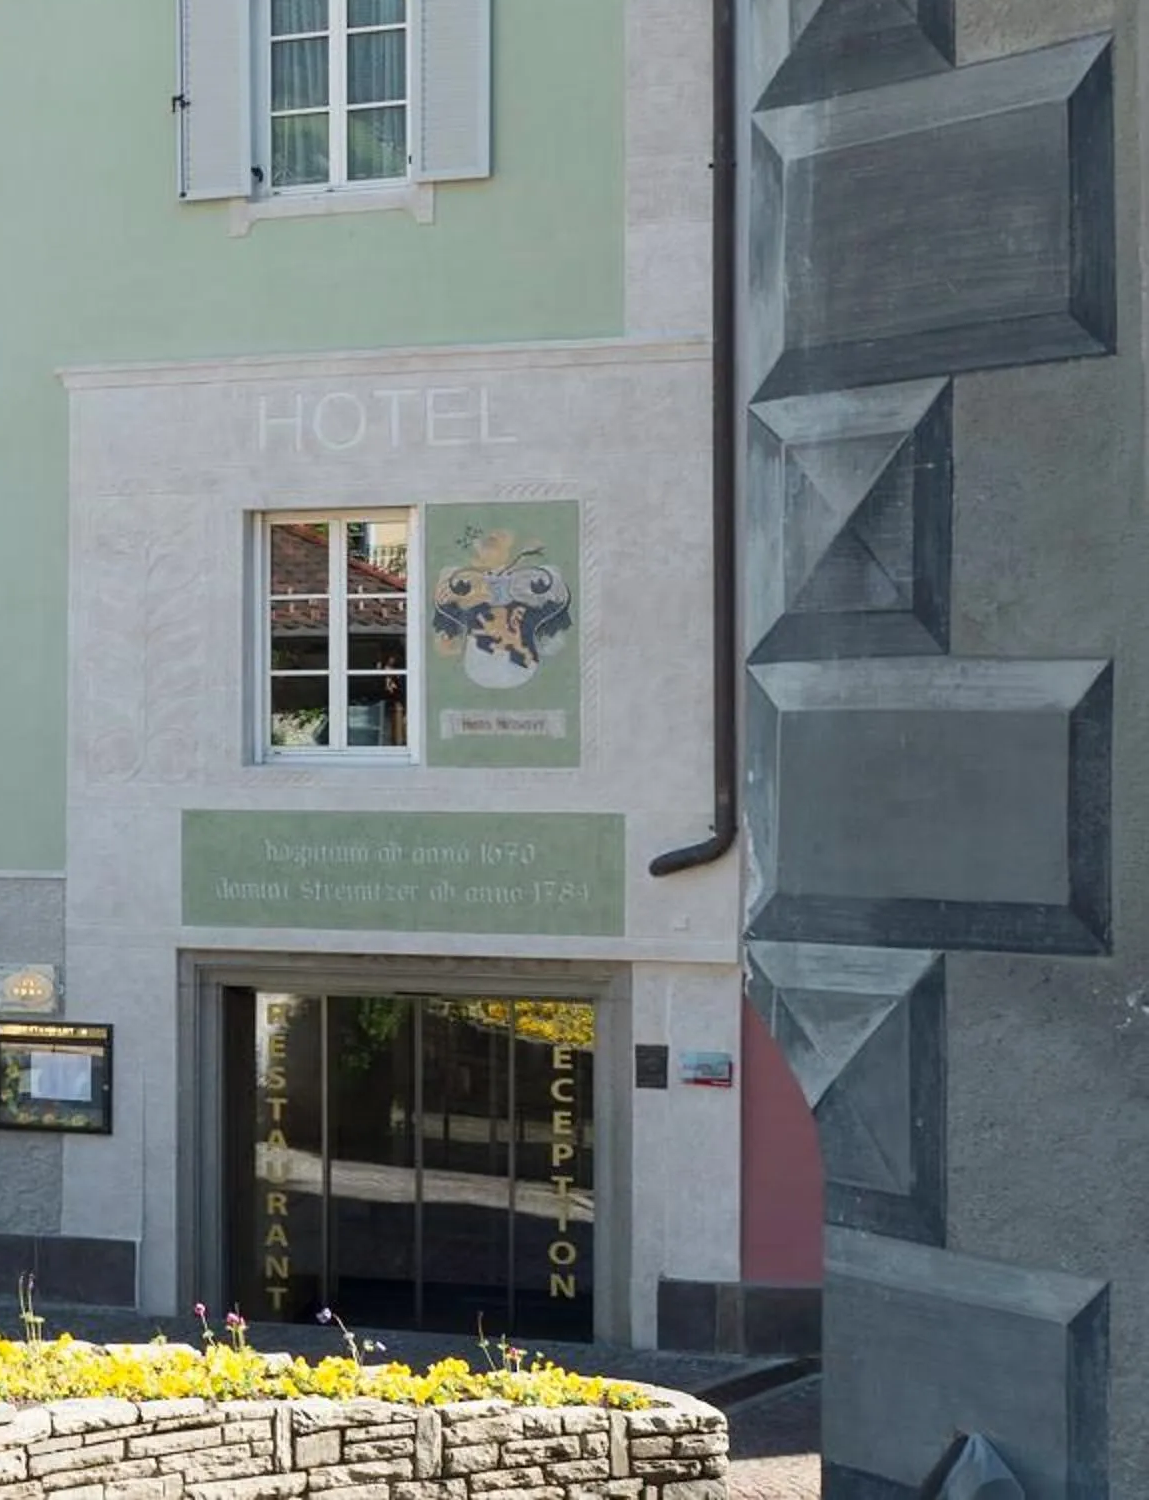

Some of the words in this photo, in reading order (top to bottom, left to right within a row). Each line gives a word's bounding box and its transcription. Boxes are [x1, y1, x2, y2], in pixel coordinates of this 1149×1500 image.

[257, 385, 519, 452] HOTEL
[266, 1002, 290, 1310] RESTAURANT
[549, 1013, 576, 1299] ECEPTION
